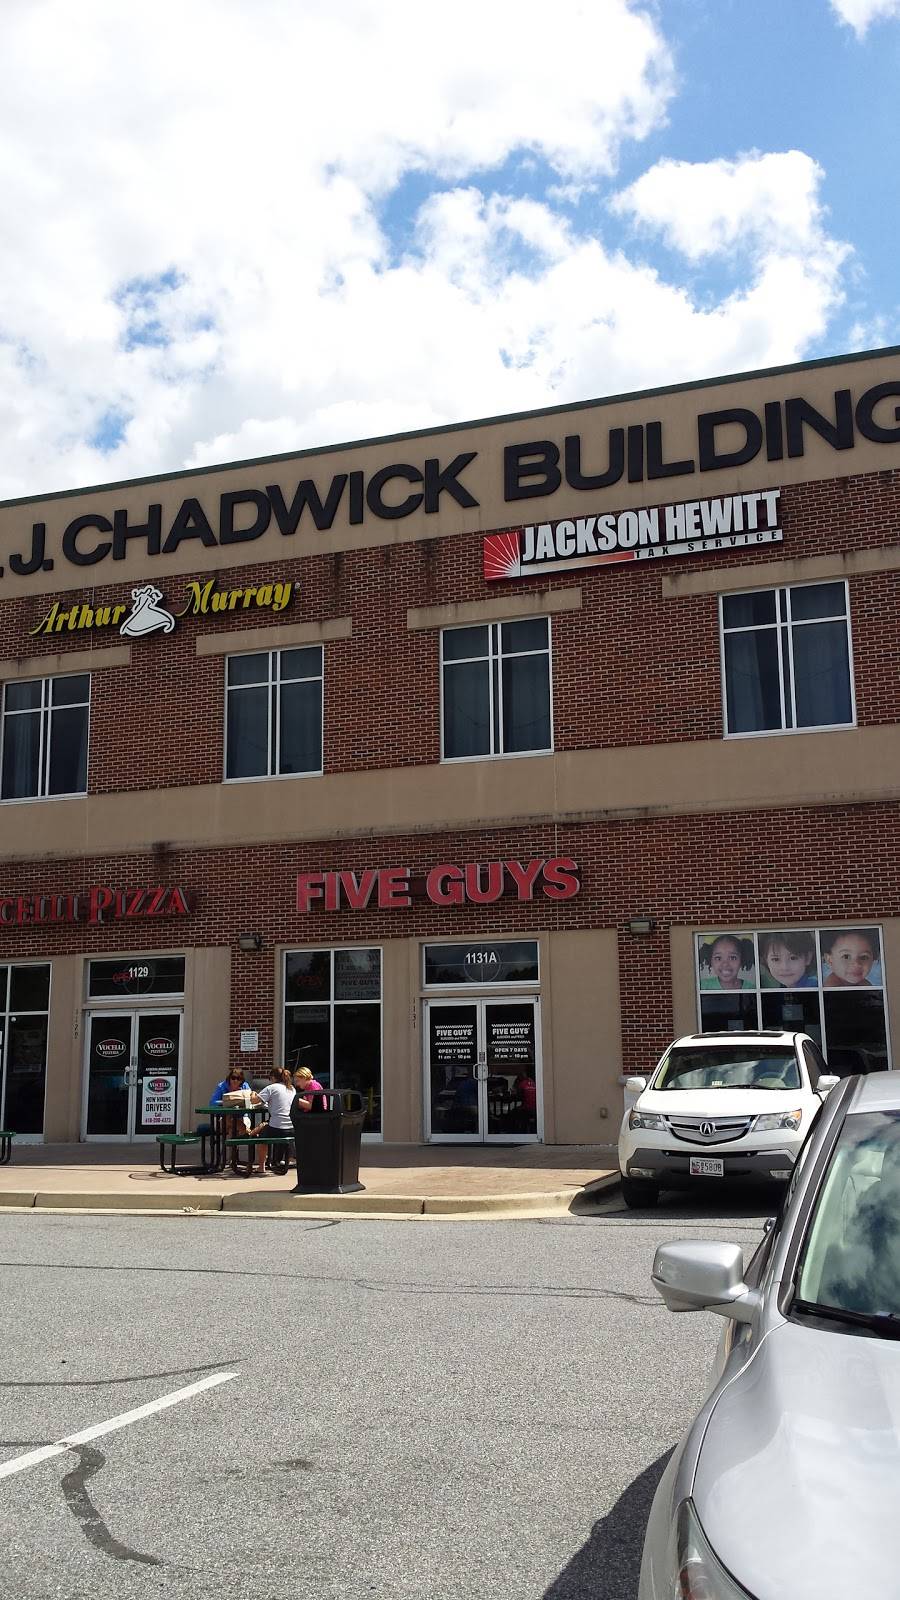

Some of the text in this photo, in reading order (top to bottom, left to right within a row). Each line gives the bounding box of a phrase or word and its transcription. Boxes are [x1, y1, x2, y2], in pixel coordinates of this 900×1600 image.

[62, 452, 480, 566] CHADWICK
[504, 381, 900, 502] BUILDING
[522, 490, 780, 562] JACKSON HEWITT
[634, 531, 778, 559] TAX SERVICE
[29, 601, 126, 635] Arthur
[296, 858, 580, 912] FIVE GUYS
[88, 885, 190, 924] PIZZA
[465, 951, 497, 964] 1131A
[128, 966, 149, 978] 1129
[436, 1029, 452, 1037] FIVE
[509, 1027, 528, 1035] GUYS
[98, 1044, 124, 1052] VOCELLI
[146, 1042, 173, 1050] VOCELLI
[145, 1103, 171, 1112] DRIVERS
